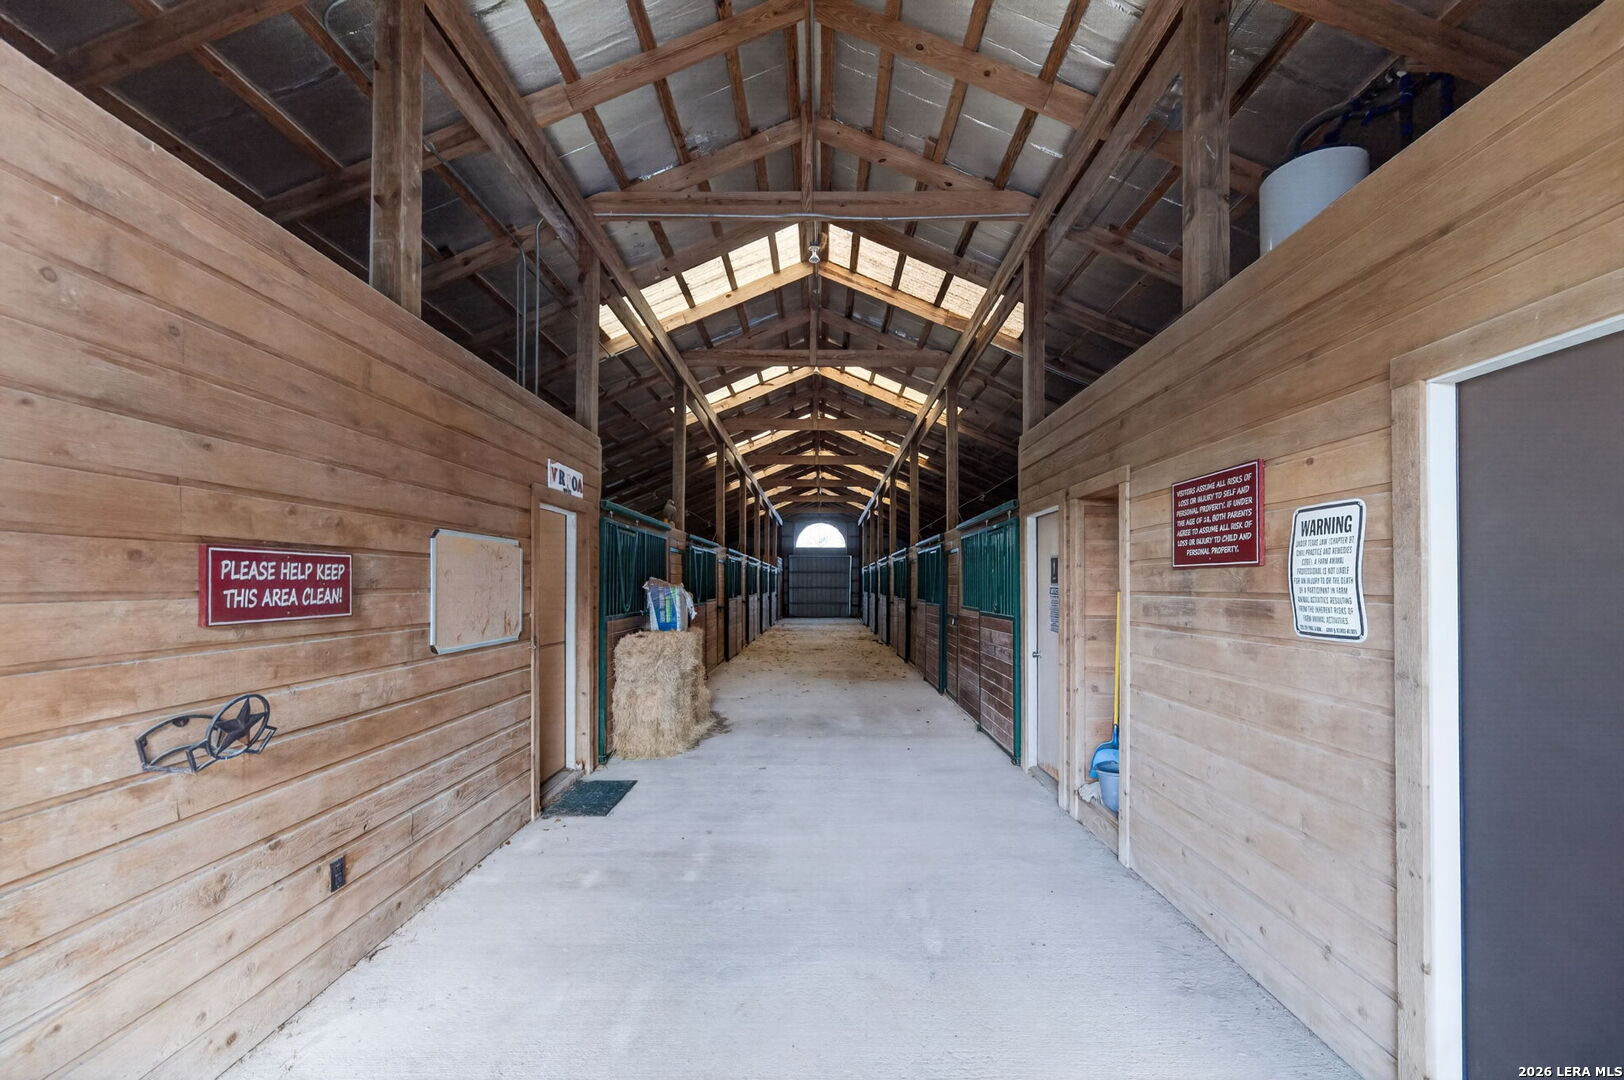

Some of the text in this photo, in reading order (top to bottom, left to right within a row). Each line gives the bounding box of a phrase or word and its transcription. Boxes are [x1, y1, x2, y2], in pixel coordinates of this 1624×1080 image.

[1196, 482, 1215, 492] ASSUME
[1227, 476, 1242, 485] RISKS
[1178, 499, 1189, 507] LOSS
[1223, 488, 1236, 497] SELF
[1237, 485, 1250, 494] AND
[1176, 508, 1198, 517] PERSONAL
[1233, 497, 1252, 506] UNDER
[1212, 513, 1226, 522] BOTH
[1227, 509, 1252, 519] PARENTS
[1199, 525, 1218, 534] ASSUME
[1231, 522, 1243, 530] RISK
[1301, 515, 1352, 537] WARNING
[1222, 534, 1238, 542] CHILD
[220, 560, 345, 580] PLEASE HELP KEEP
[223, 587, 343, 608] THIS AREA CLEAN!
